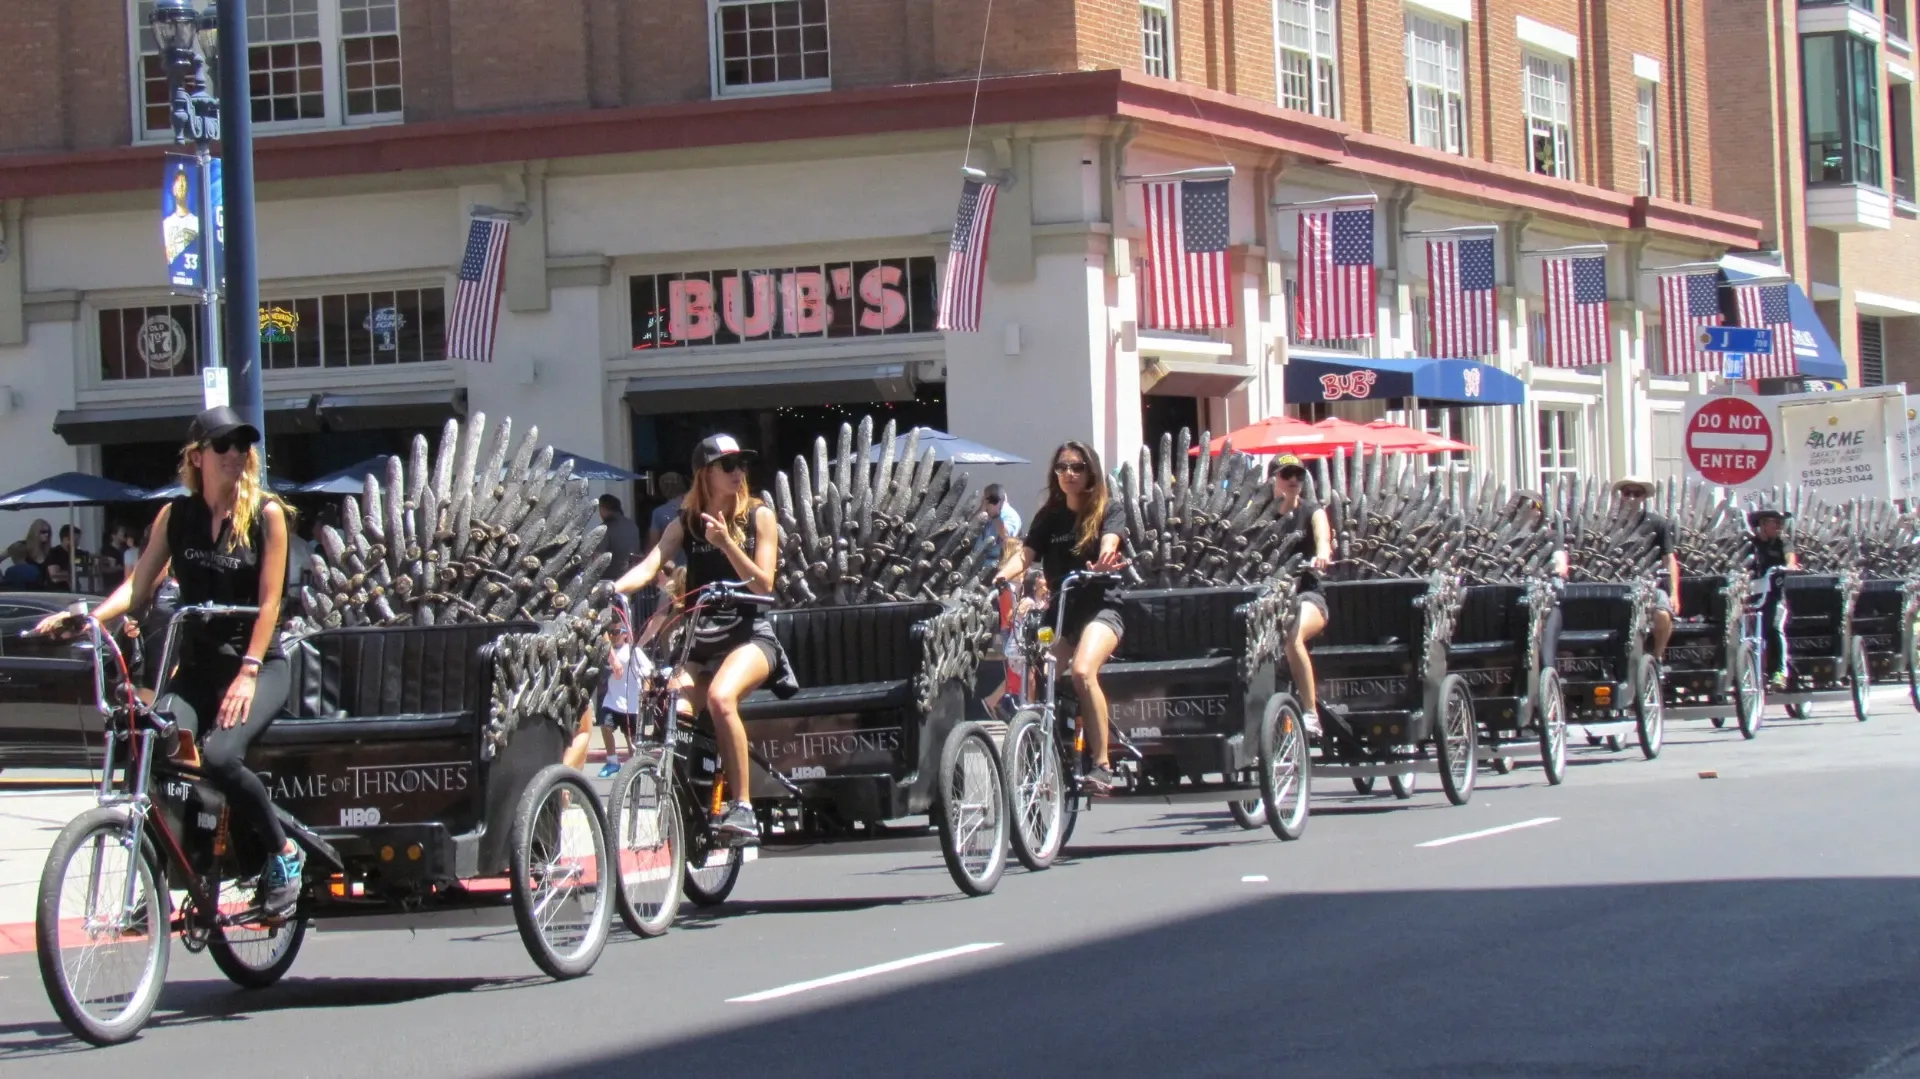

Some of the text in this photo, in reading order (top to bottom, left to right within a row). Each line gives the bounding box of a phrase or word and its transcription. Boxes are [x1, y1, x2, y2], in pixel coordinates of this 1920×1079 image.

[184, 253, 199, 270] 33
[668, 265, 908, 341] BUB'S
[149, 324, 165, 332] OLD
[1720, 331, 1729, 348] J
[1698, 413, 1763, 430] DO NOT
[1814, 430, 1866, 449] ACME
[1700, 453, 1758, 470] ENTER
[1457, 667, 1513, 686] RONES
[1324, 675, 1408, 699] THRONES
[1134, 694, 1229, 721] THRONES
[783, 741, 798, 754] OF
[795, 726, 902, 759] THRONES
[331, 777, 350, 792] OF
[346, 761, 472, 799] THRONES
[339, 807, 381, 827] HBO
